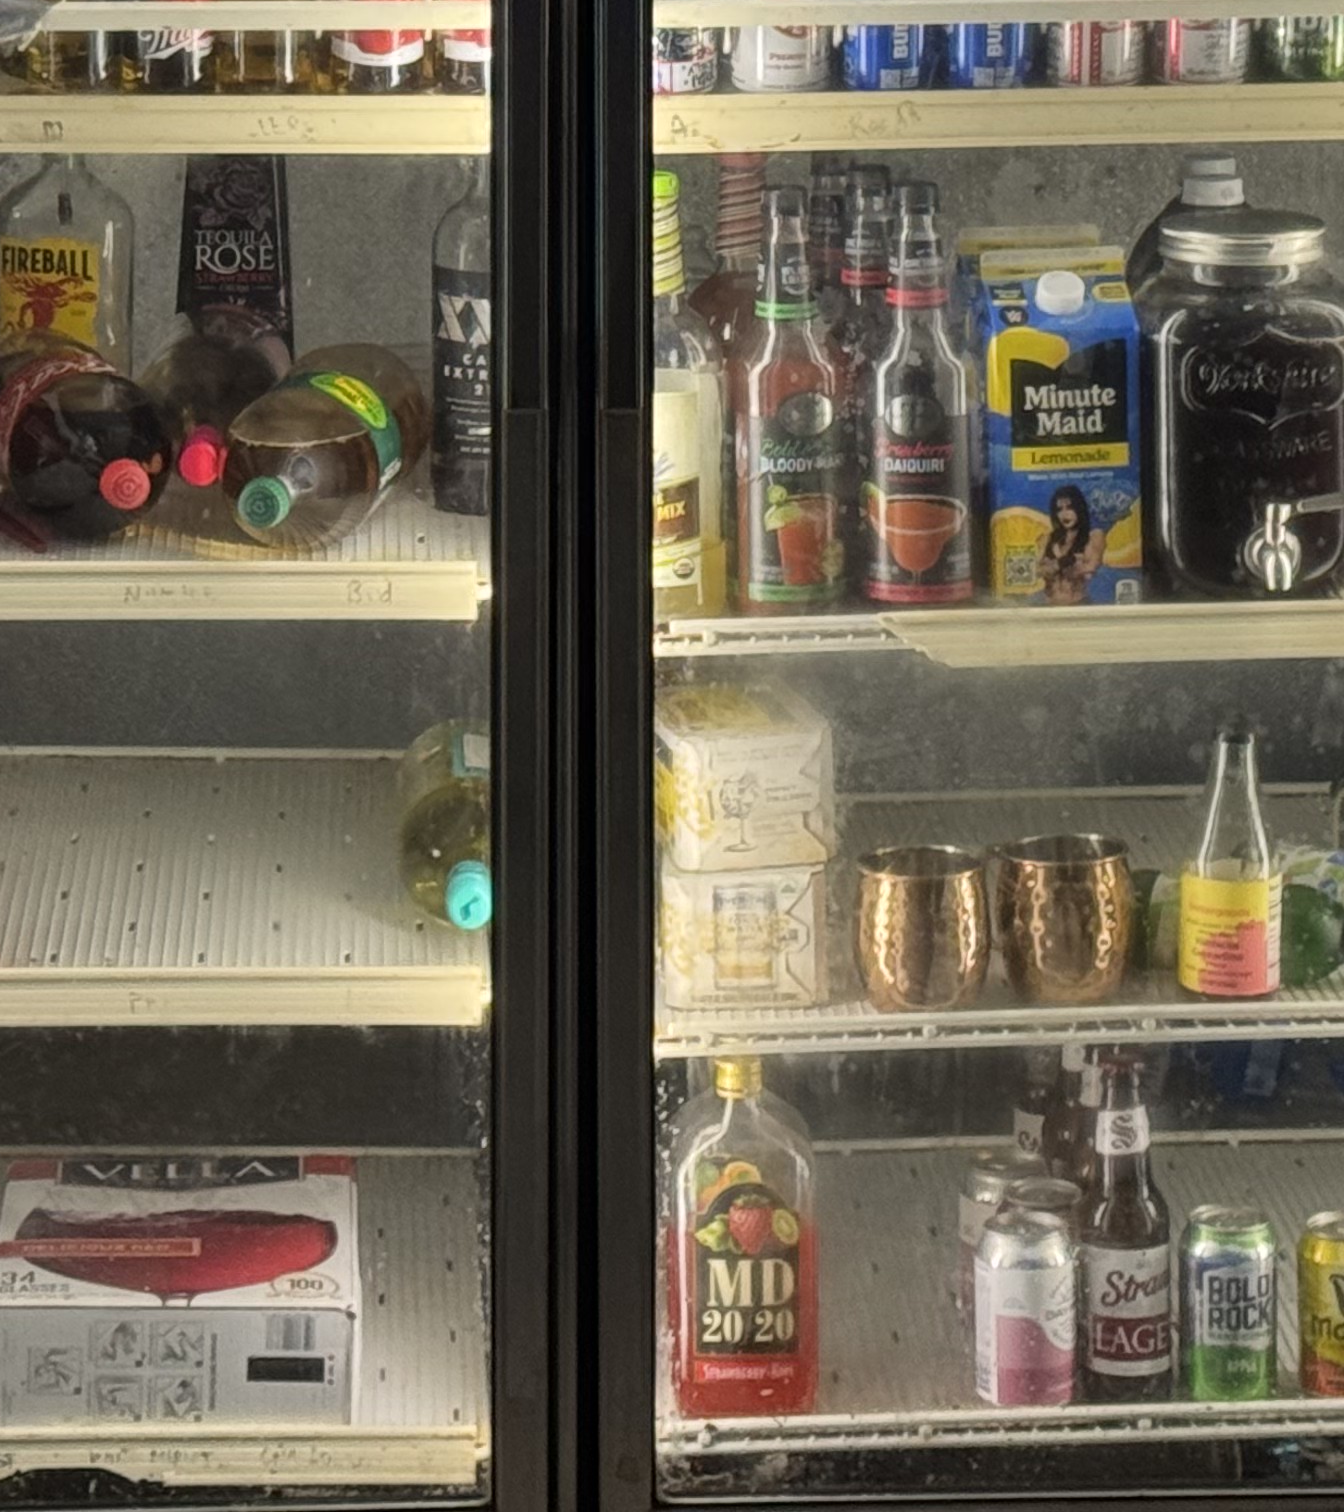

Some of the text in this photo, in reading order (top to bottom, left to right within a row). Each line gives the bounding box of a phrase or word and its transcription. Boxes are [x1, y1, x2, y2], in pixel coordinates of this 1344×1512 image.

[194, 228, 275, 249] TEQUILA
[0, 244, 94, 281] FIREBALL
[194, 245, 277, 275] ROSE
[1023, 383, 1118, 413] Minute
[1036, 407, 1105, 438] Maid
[760, 457, 813, 475] BLOODY
[883, 457, 945, 475] DAIQUIRI
[1030, 448, 1112, 467] Lemonade
[657, 501, 687, 524] MIX
[82, 1161, 277, 1181] VELLA
[286, 1278, 324, 1291] 100
[707, 1257, 796, 1309] MD
[1208, 1274, 1270, 1304] BOLD
[702, 1309, 796, 1344] 20 20
[1207, 1299, 1271, 1332] ROCK
